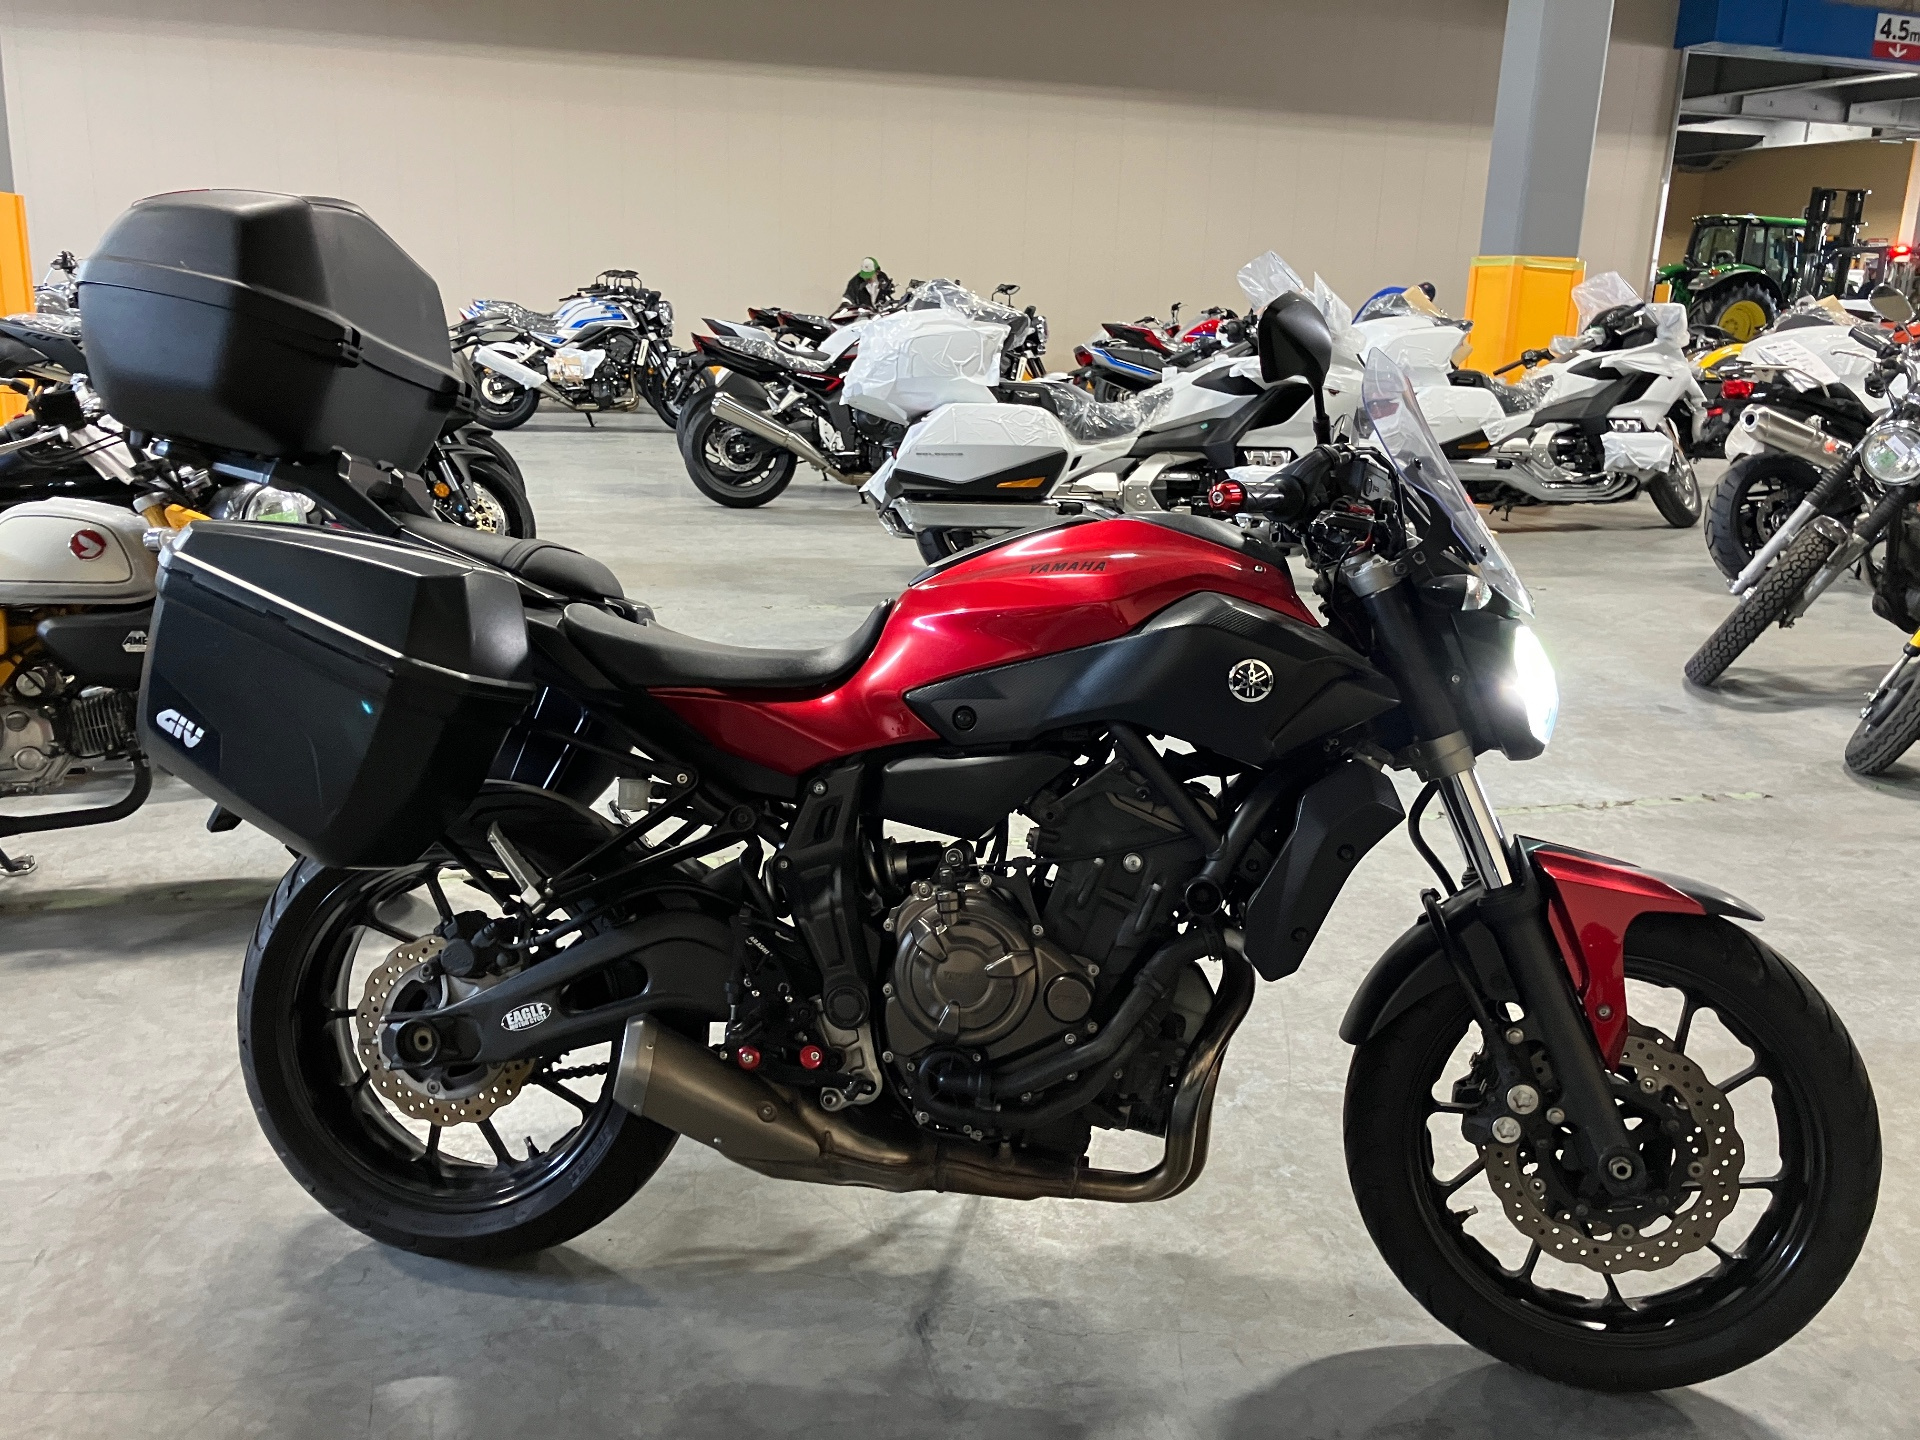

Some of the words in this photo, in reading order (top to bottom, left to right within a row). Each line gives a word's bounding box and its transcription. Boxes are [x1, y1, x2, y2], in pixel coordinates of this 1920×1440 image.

[1880, 17, 1920, 42] 4.5m
[1029, 561, 1106, 574] YAMAHA
[505, 1002, 547, 1025] EAGLE
